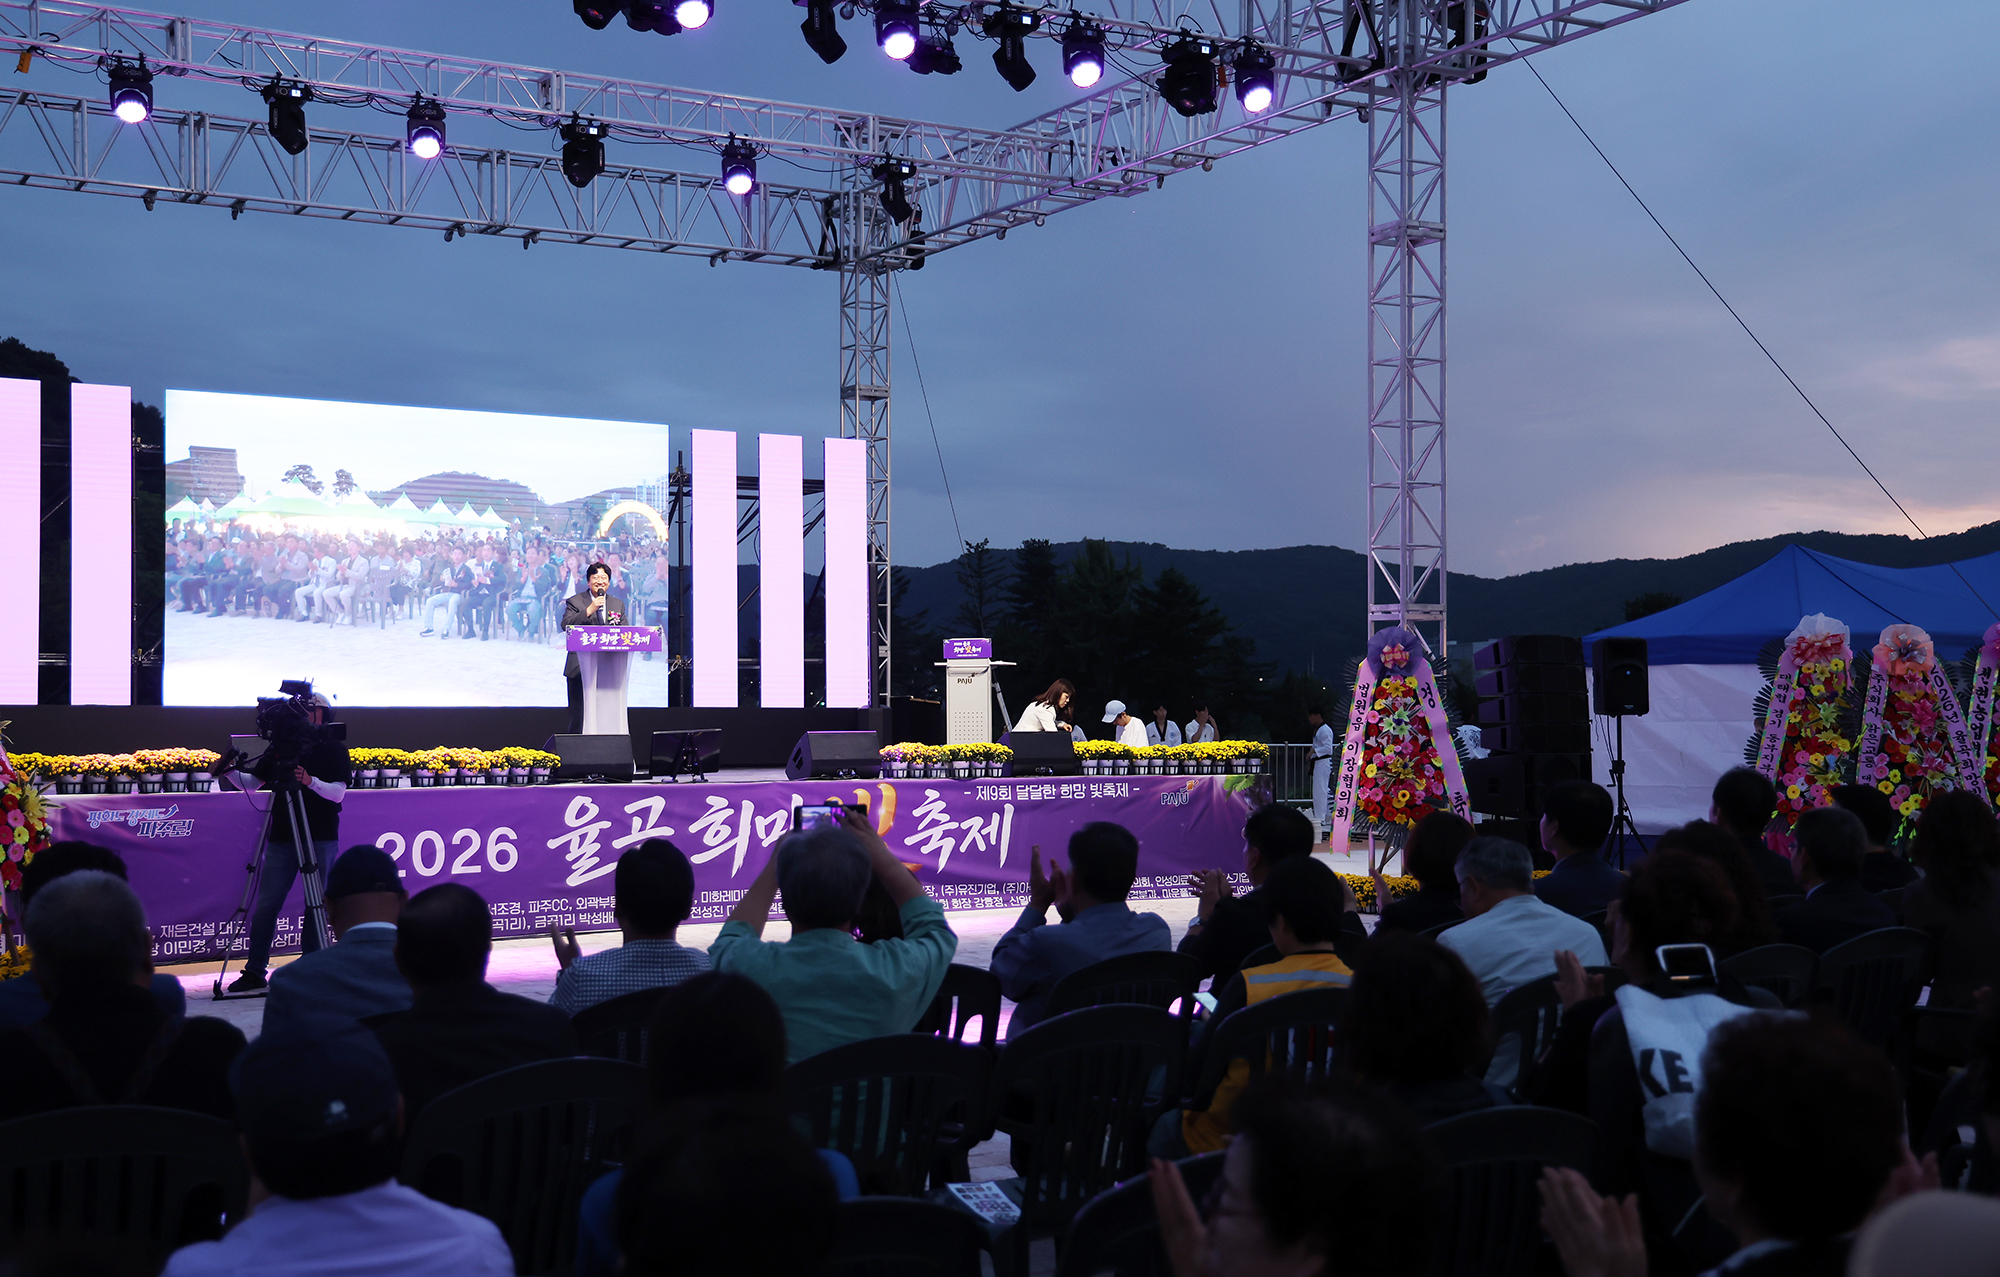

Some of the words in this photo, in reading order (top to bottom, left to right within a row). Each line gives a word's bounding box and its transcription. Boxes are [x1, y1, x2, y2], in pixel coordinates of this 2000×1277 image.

[600, 634, 620, 646] 희망
[621, 631, 635, 646] 빛
[632, 634, 651, 646] 축제
[1421, 682, 1436, 709] 경
[1769, 709, 1784, 728] 경기
[1760, 734, 1780, 779] 동부지부
[1336, 741, 1358, 821] 이장협의회
[976, 785, 1012, 801] 제9회
[1016, 785, 1056, 800] 달달한
[1060, 784, 1086, 799] 희망
[1090, 782, 1129, 798] 빛축제
[1161, 791, 1189, 806] PAJU
[137, 819, 194, 838] 파주로!
[375, 826, 519, 877] 2026
[904, 788, 1015, 875] 축제
[1002, 881, 1031, 894] (주)아
[528, 898, 572, 914] 파주CC,
[690, 905, 724, 919] 전성진
[492, 917, 531, 931] 곡1리),
[164, 937, 211, 955] 이민경,
